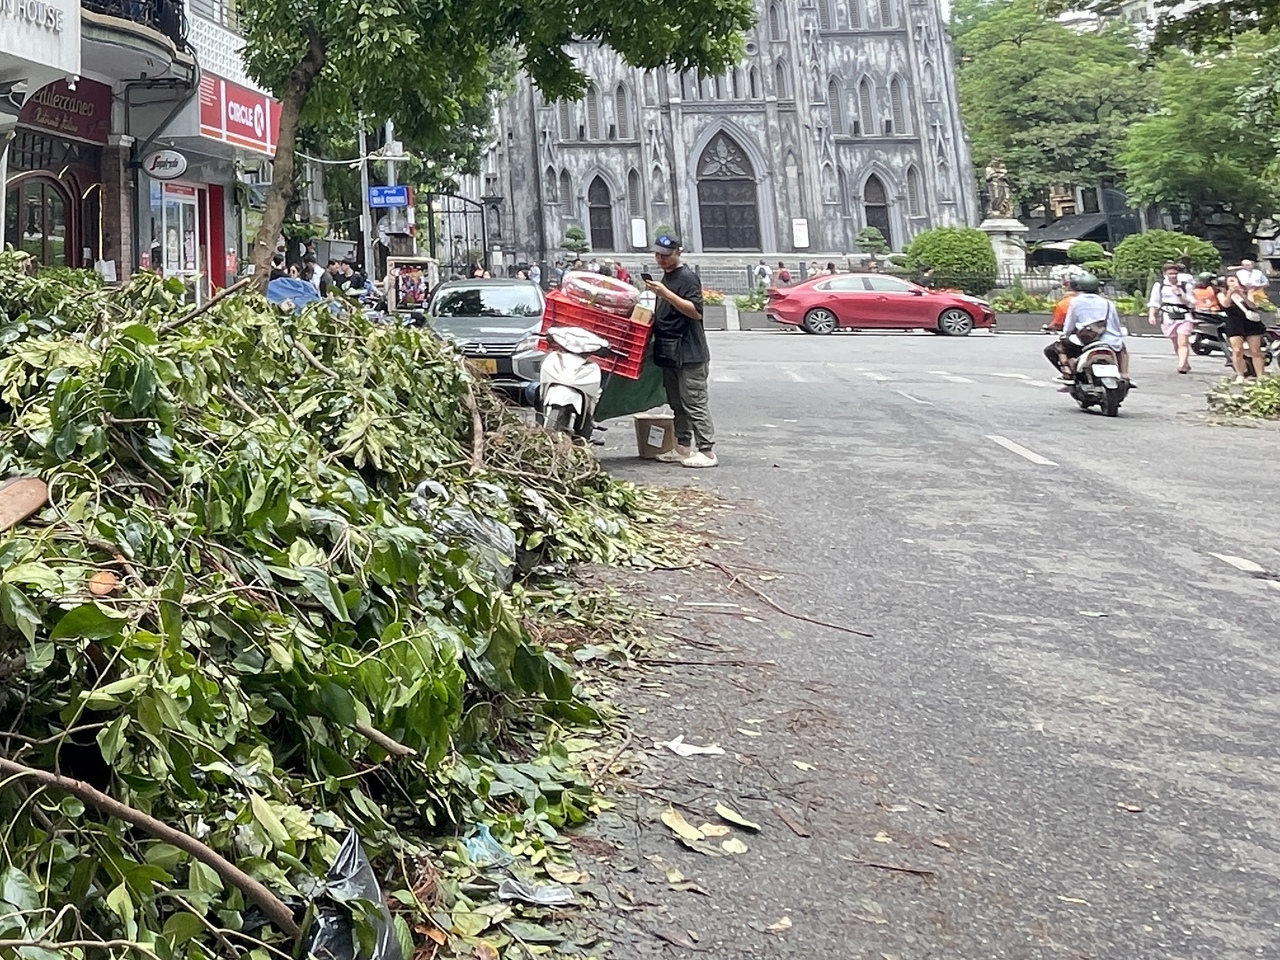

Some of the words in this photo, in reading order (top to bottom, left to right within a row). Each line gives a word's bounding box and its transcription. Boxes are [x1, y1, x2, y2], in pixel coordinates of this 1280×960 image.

[30, 84, 94, 117] editerraneo
[228, 100, 254, 127] CIRCLE
[254, 104, 265, 137] K
